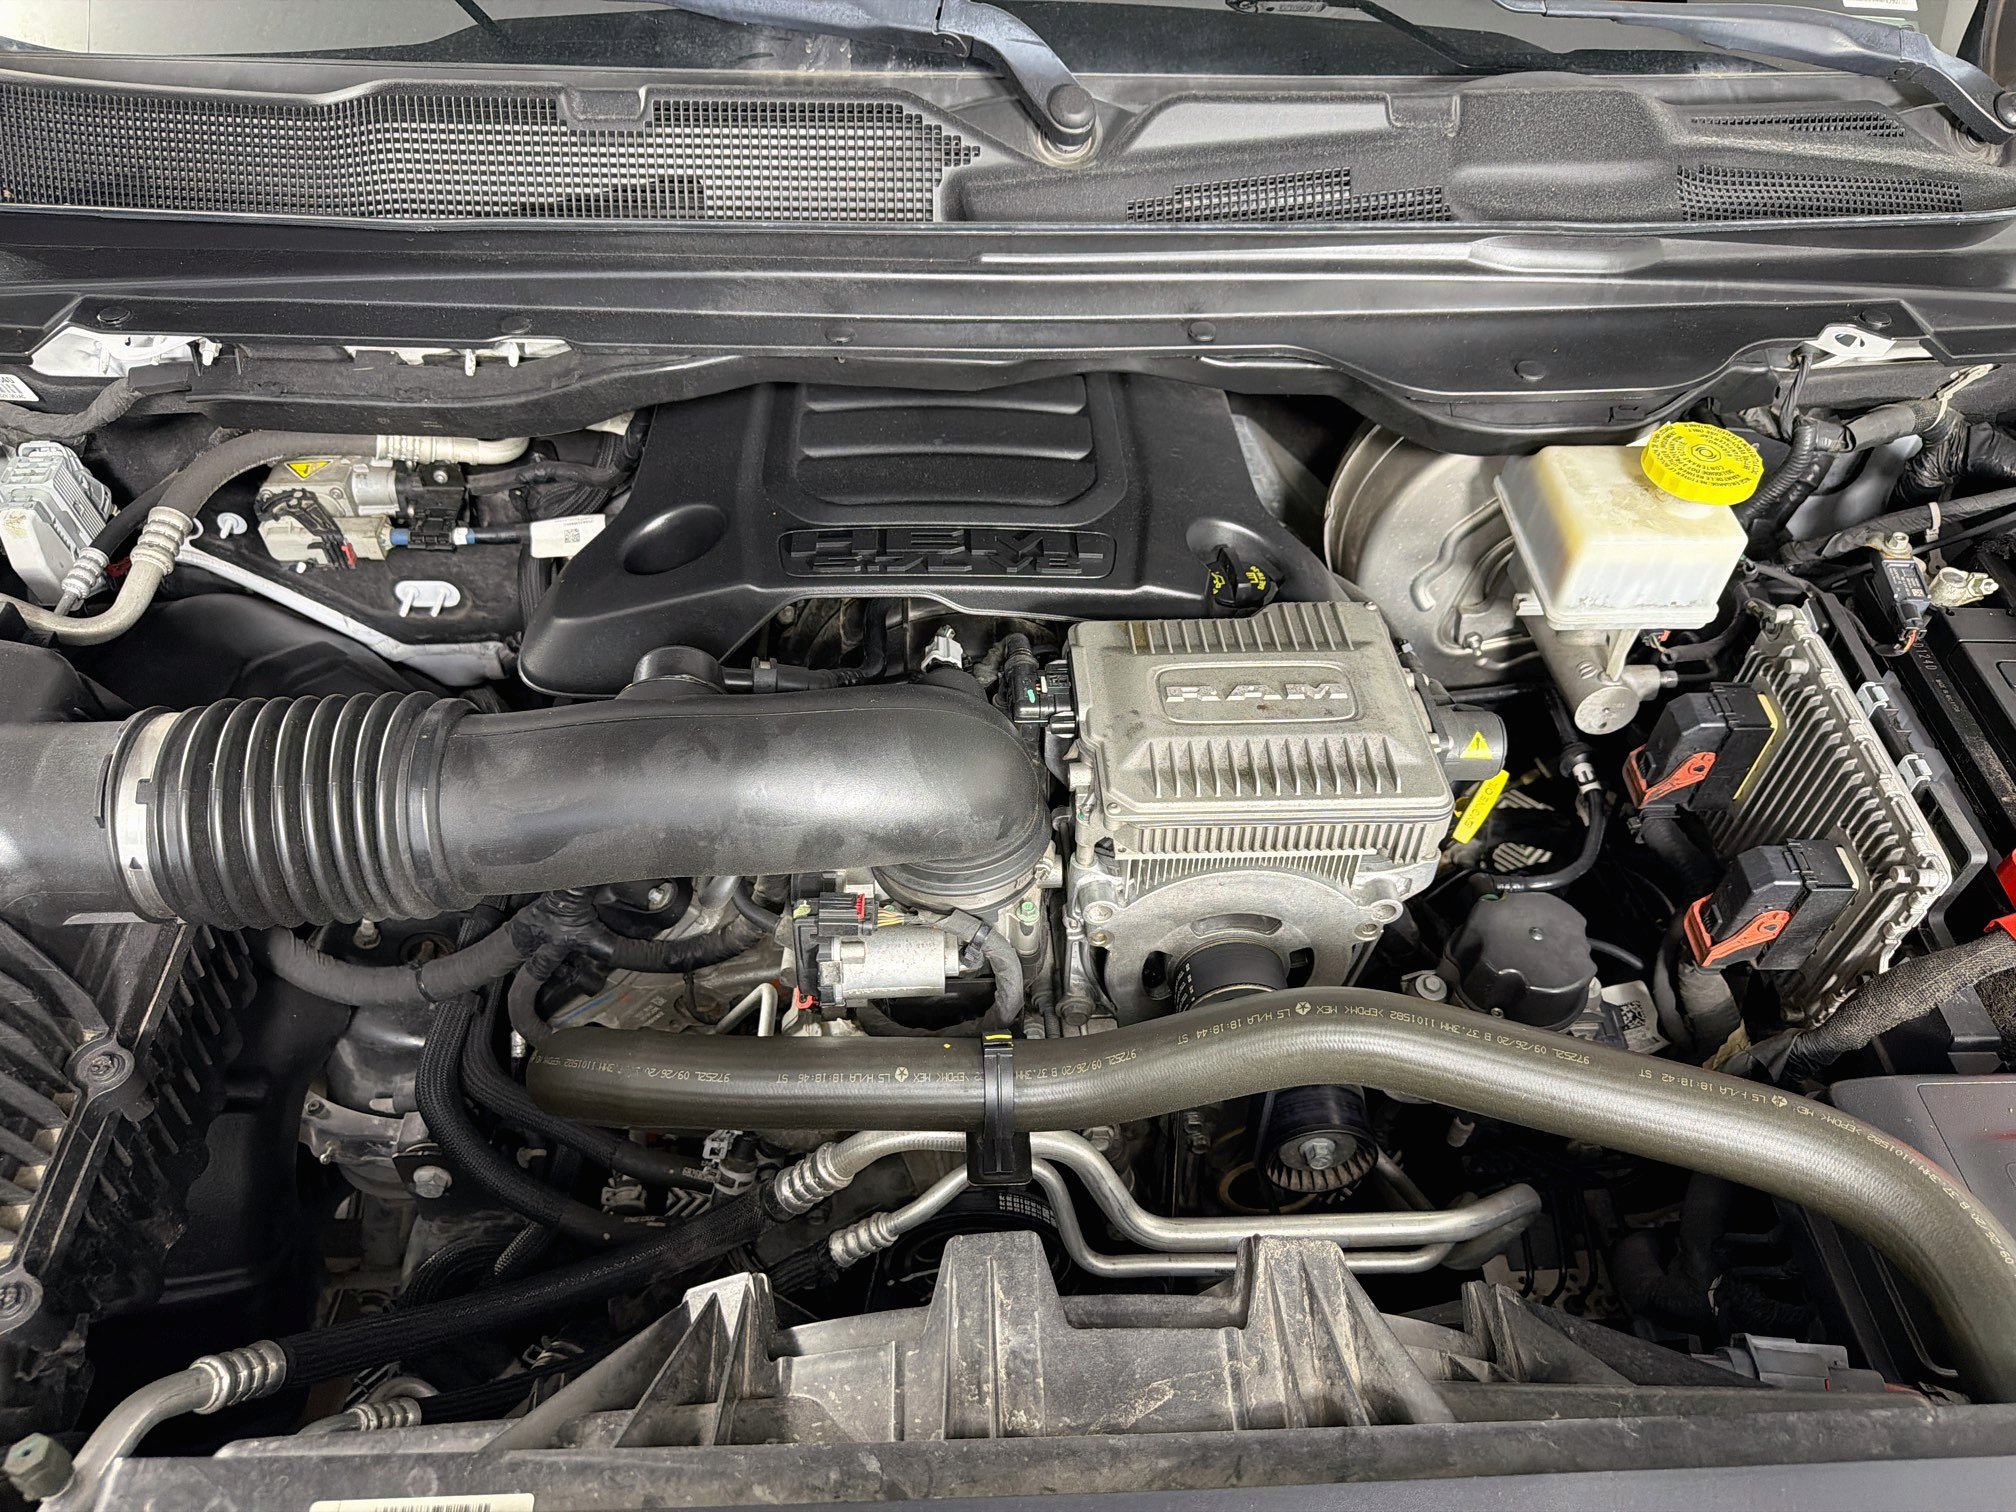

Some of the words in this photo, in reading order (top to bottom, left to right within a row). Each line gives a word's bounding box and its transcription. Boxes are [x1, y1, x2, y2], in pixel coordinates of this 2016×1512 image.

[790, 529, 1104, 558] HEMI
[1164, 683, 1349, 702] RAM
[1316, 1005, 1338, 1014] MEX
[1196, 1018, 1242, 1039] 18:18:44
[1440, 1021, 1480, 1039] 37.3MM
[1496, 1035, 1547, 1055] 09/26/20
[1061, 1059, 1102, 1076] 09/26/20
[798, 1073, 844, 1084] 18:18:46
[913, 1072, 931, 1083] MEX
[1661, 1073, 1713, 1092] 18:18:42
